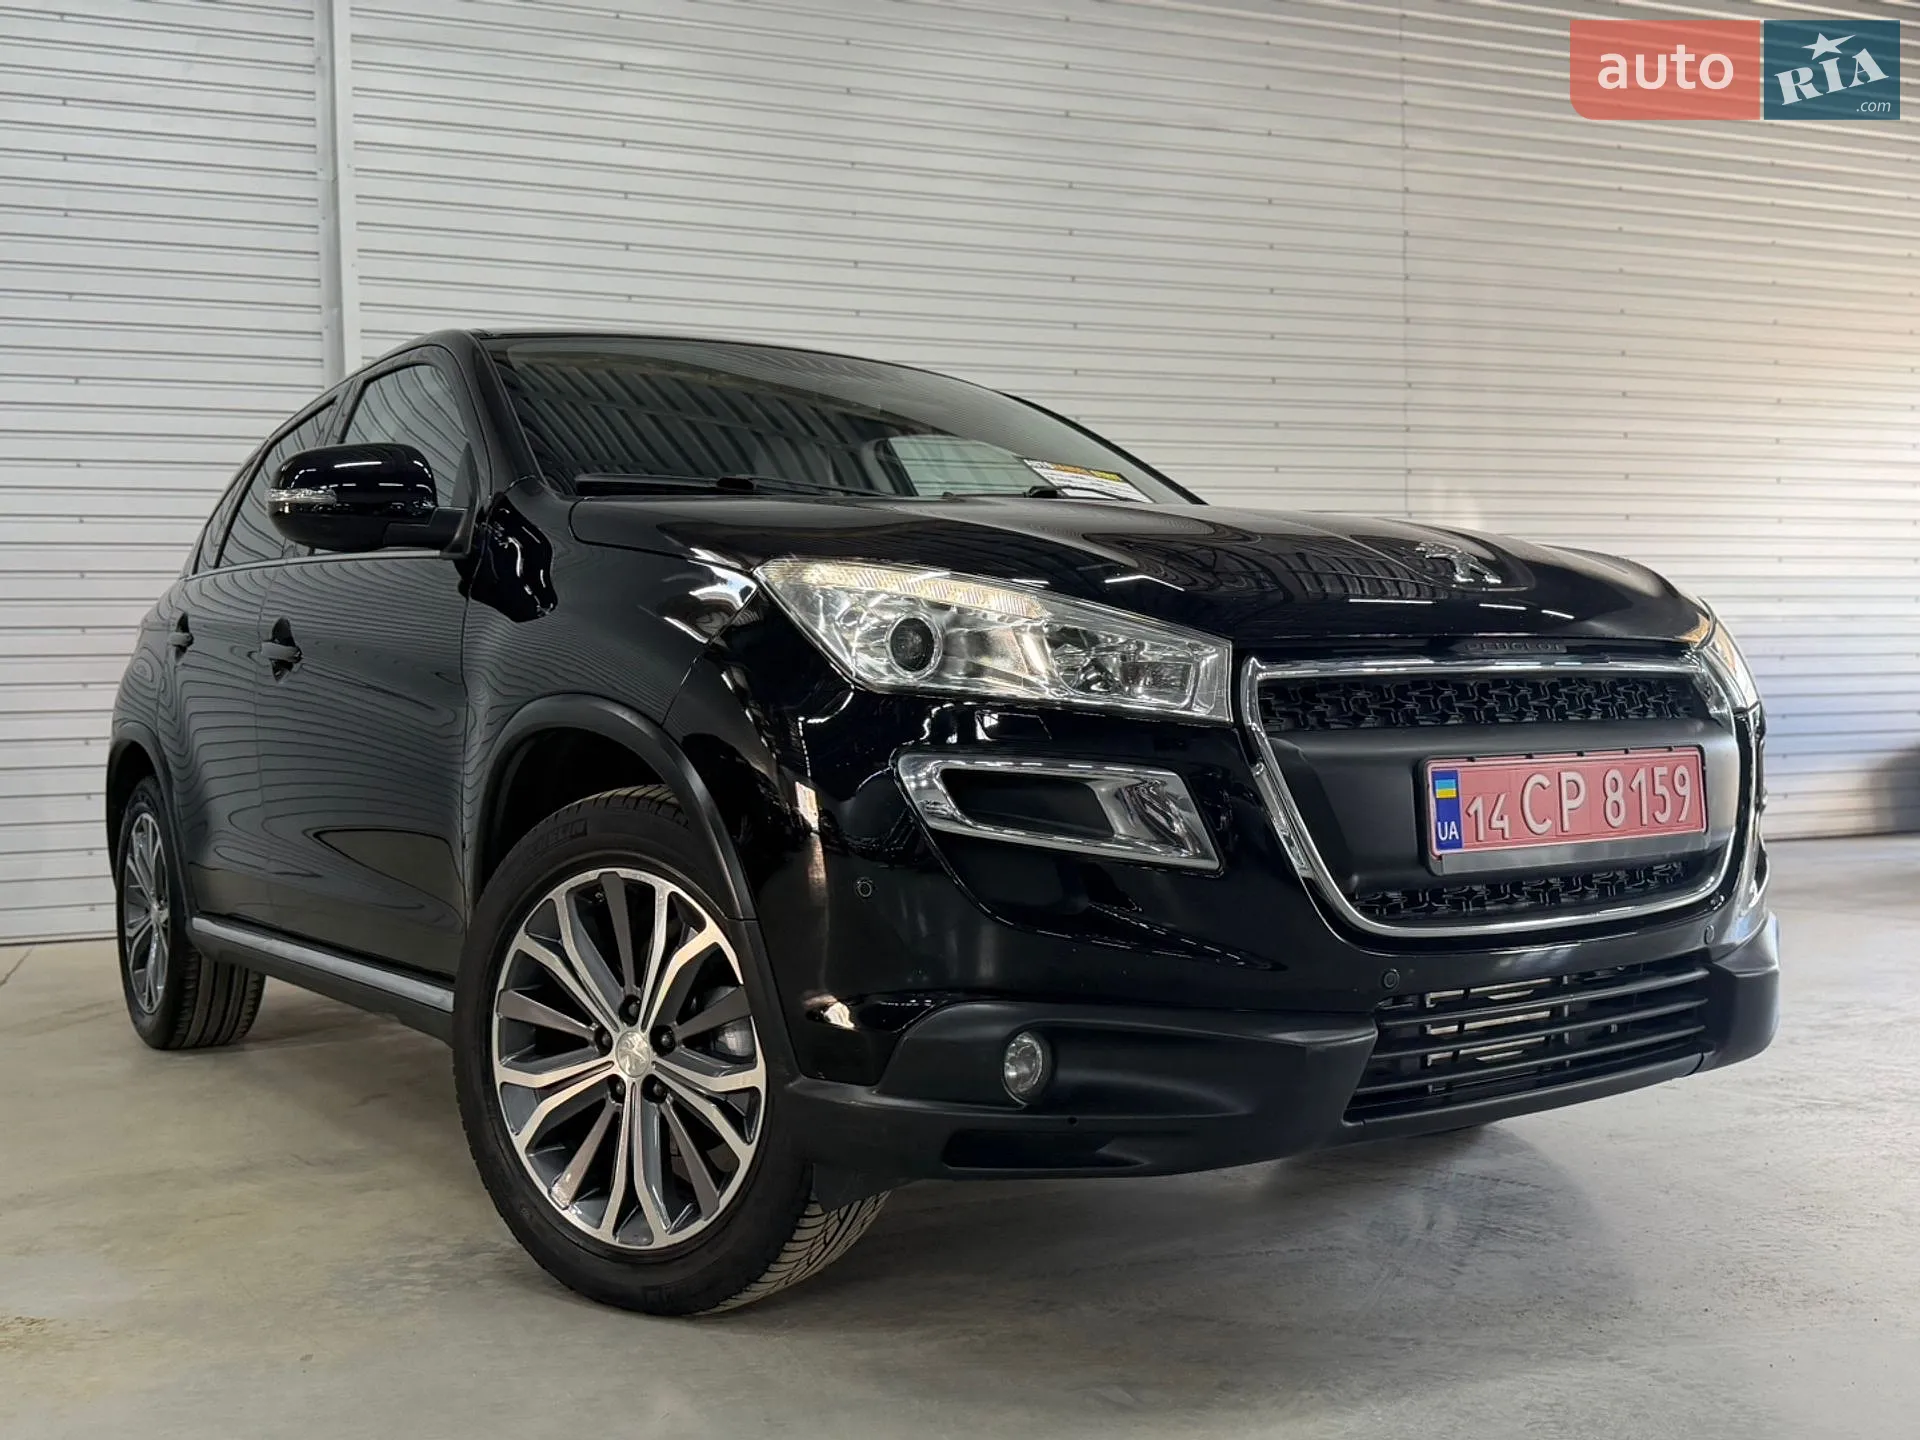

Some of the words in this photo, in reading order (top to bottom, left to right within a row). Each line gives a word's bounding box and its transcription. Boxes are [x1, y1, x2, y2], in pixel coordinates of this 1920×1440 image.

[1465, 793, 1510, 841] 14
[1521, 770, 1587, 835] CP
[1603, 764, 1691, 829] 8159
[1437, 821, 1459, 842] UA
